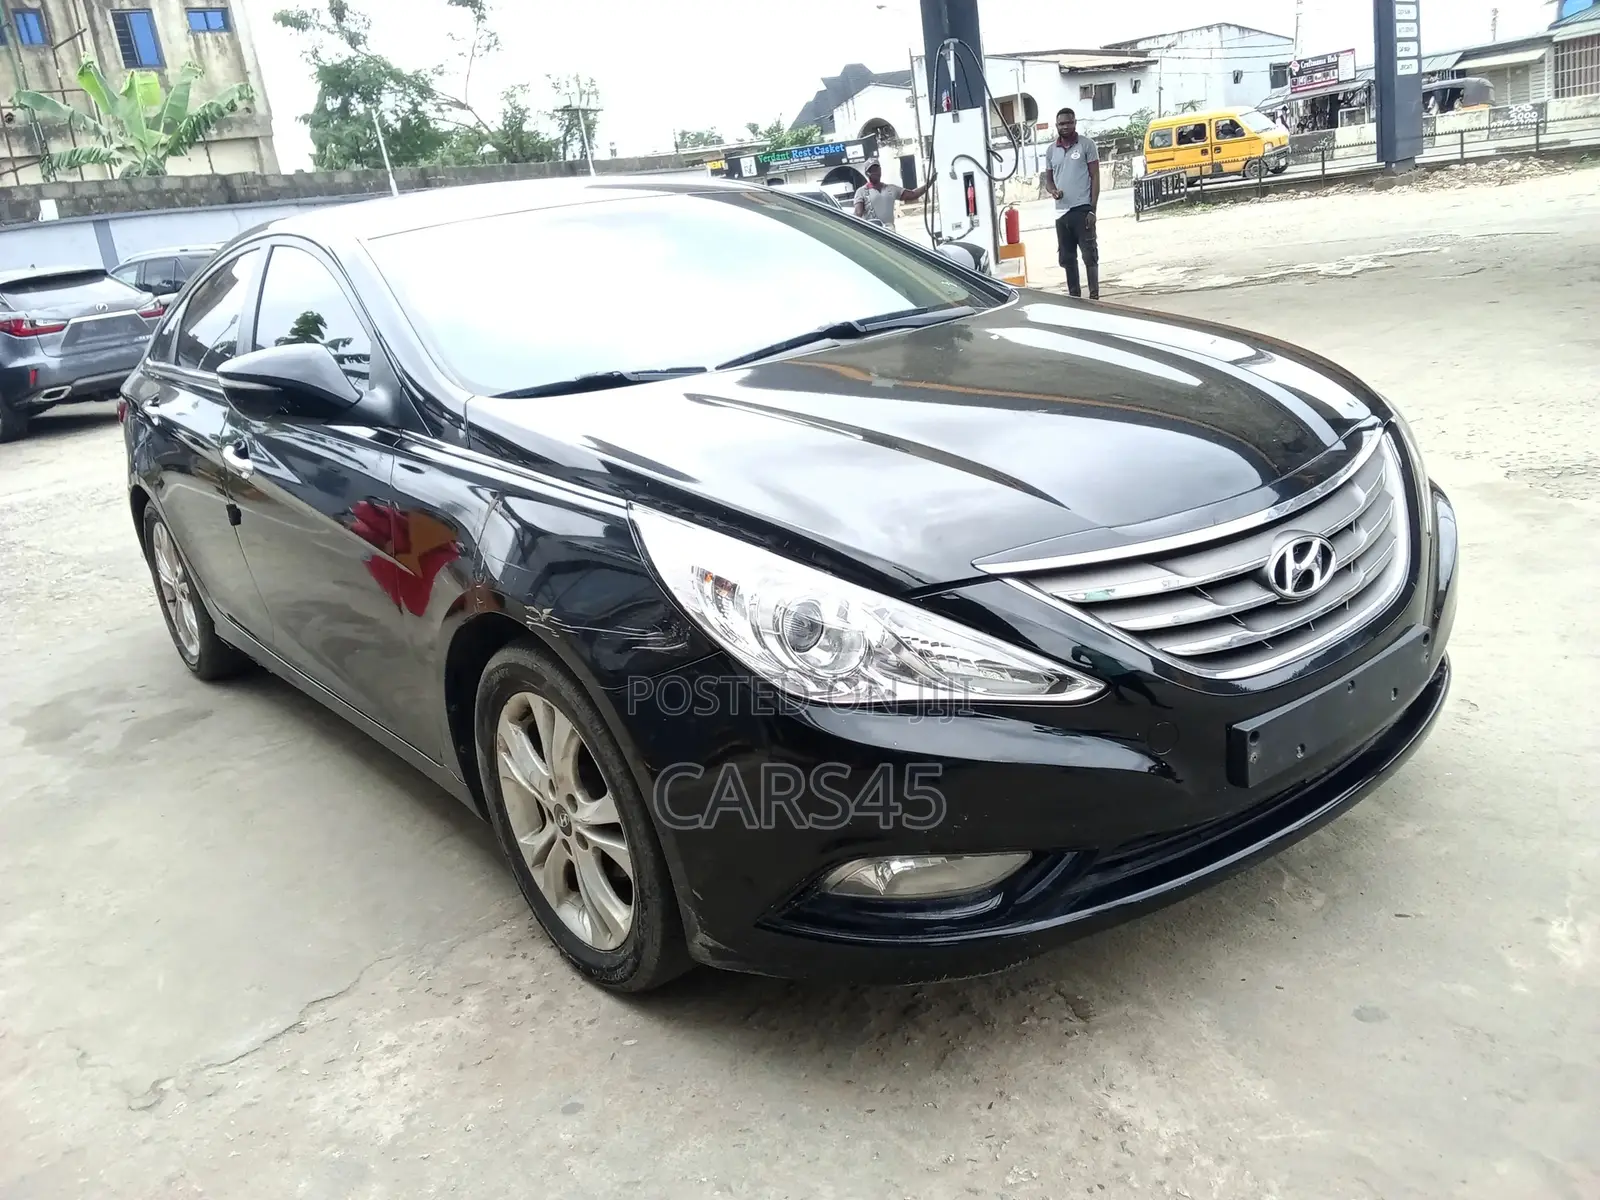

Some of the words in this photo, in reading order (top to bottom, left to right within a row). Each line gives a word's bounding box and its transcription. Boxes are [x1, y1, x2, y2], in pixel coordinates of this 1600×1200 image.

[1509, 112, 1538, 120] 5000
[758, 152, 790, 163] Verdant
[791, 148, 814, 159] Rest
[813, 143, 845, 155] Casket
